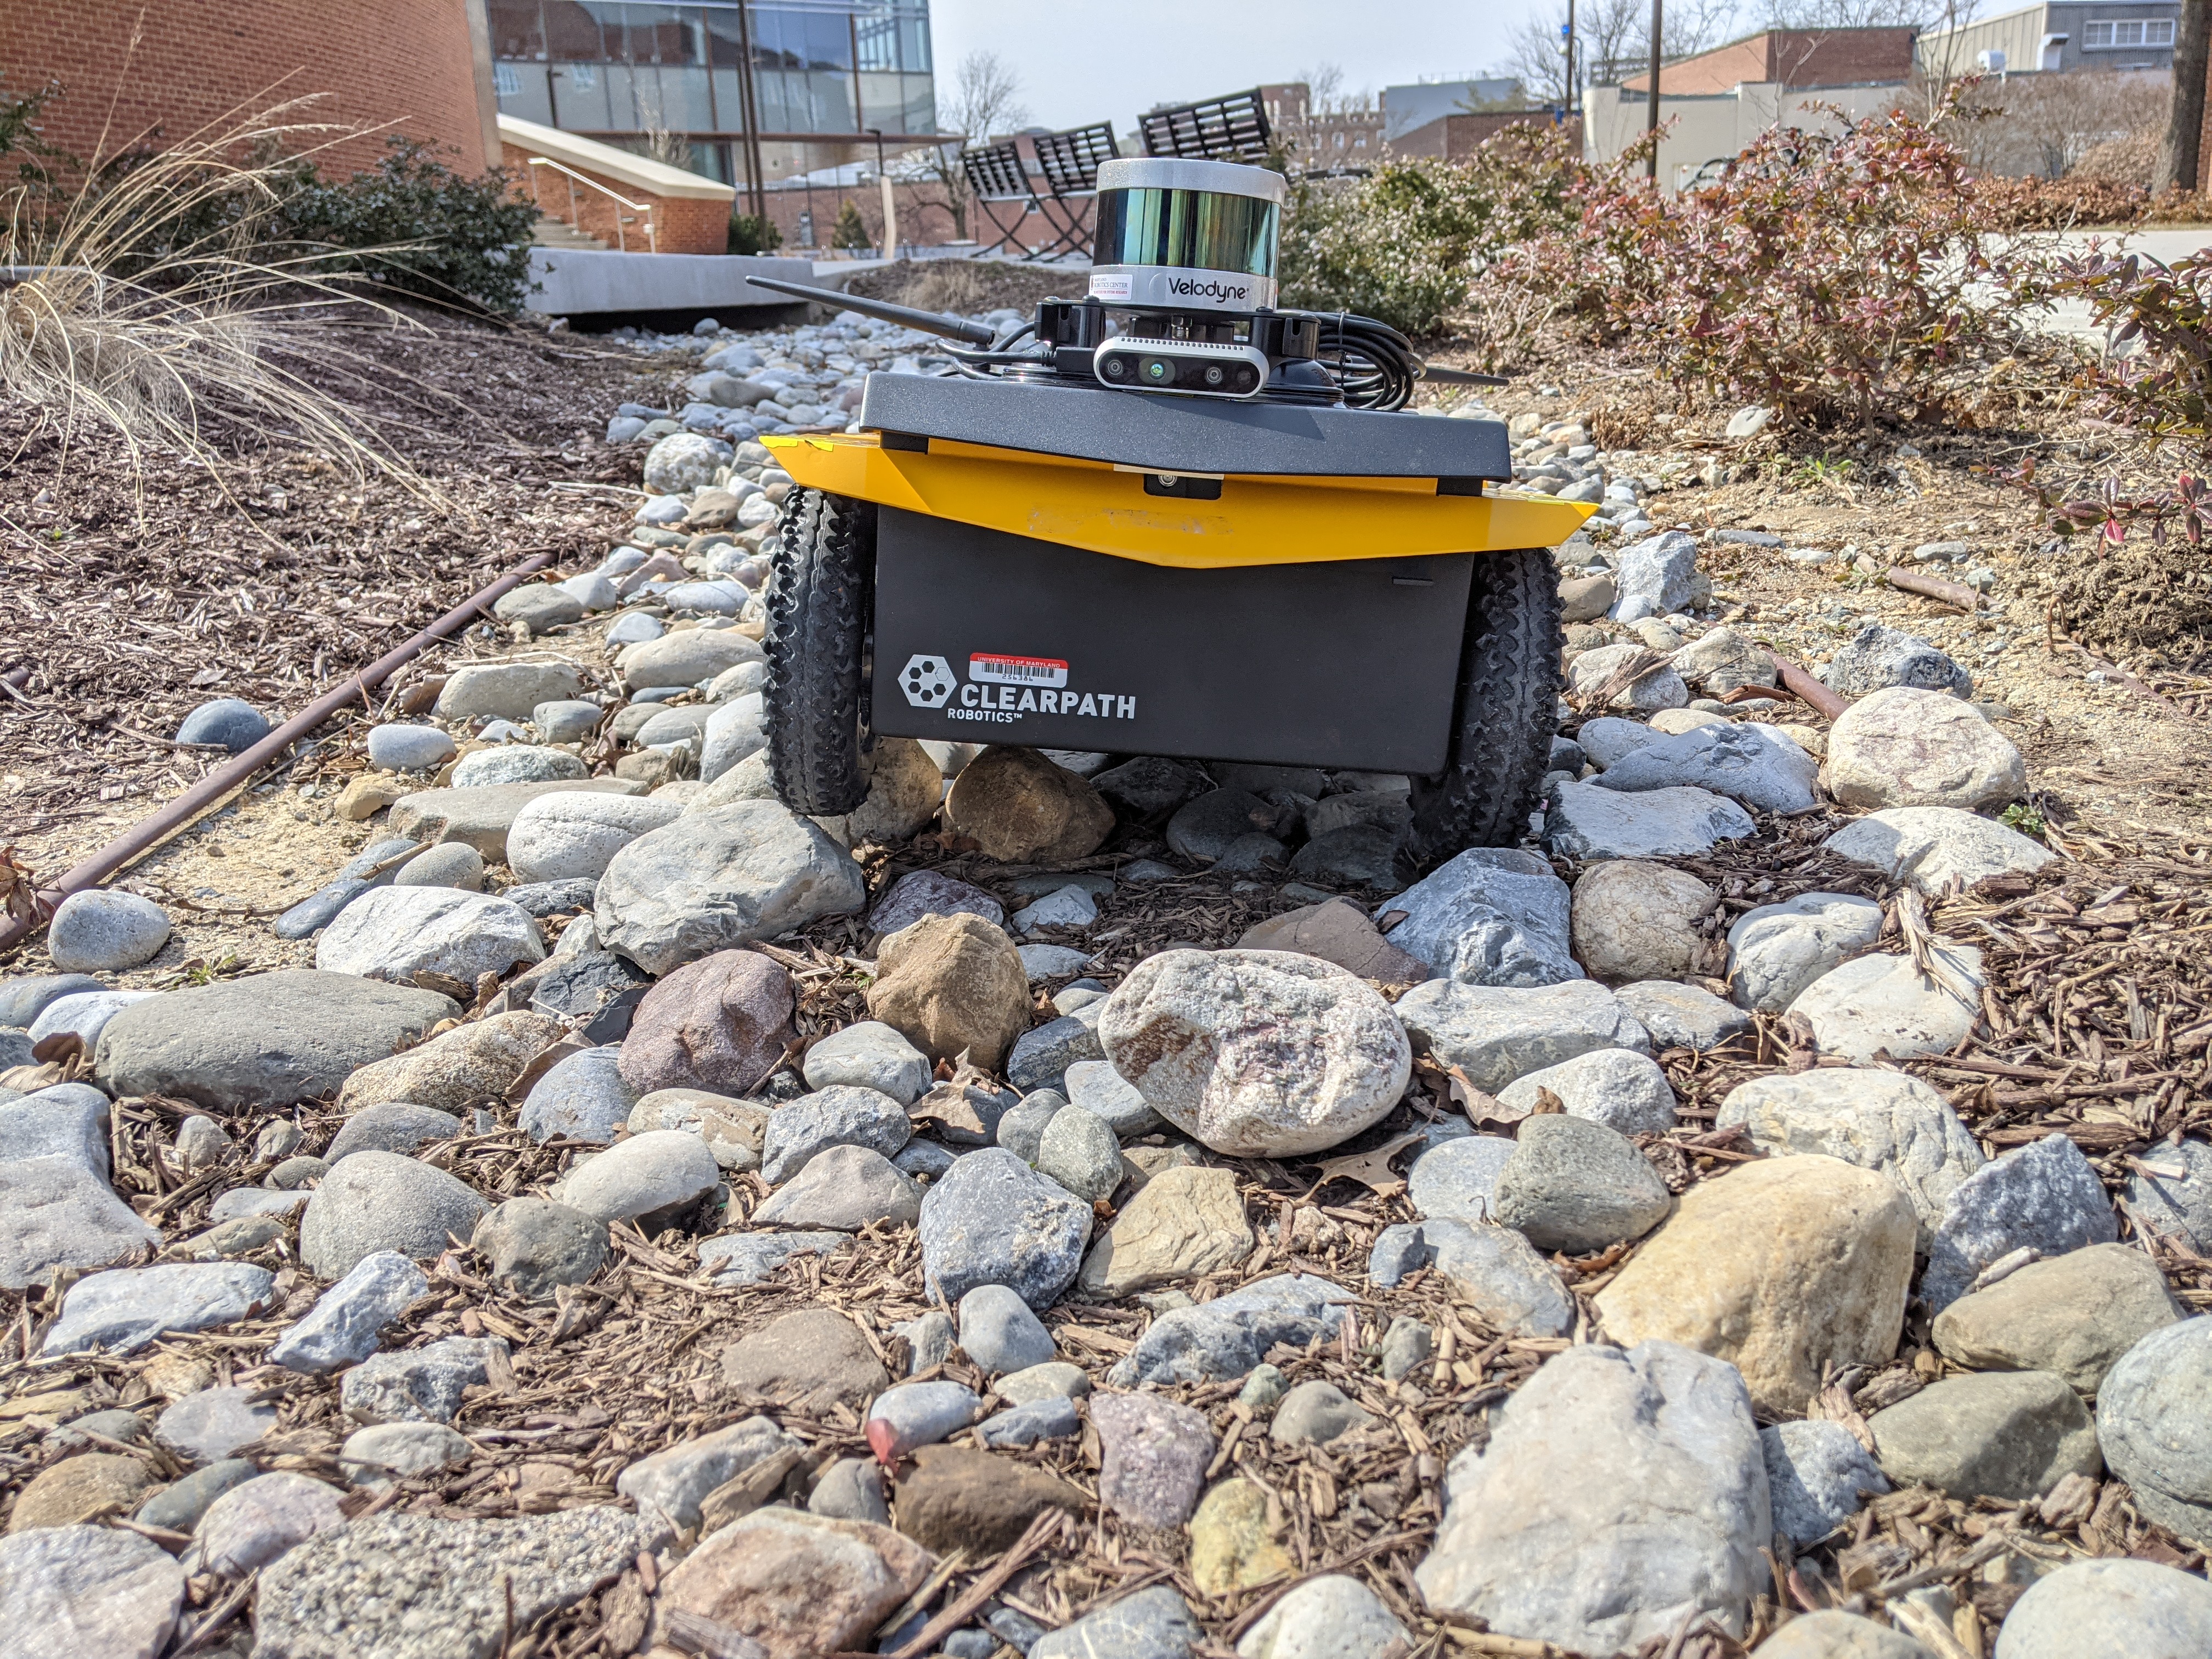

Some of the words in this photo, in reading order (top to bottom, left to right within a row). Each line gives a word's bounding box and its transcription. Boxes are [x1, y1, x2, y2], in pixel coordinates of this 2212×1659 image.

[1168, 277, 1246, 303] Velodyne
[977, 656, 1014, 664] UNIVERSITY
[961, 684, 1136, 719] CLEARPATH
